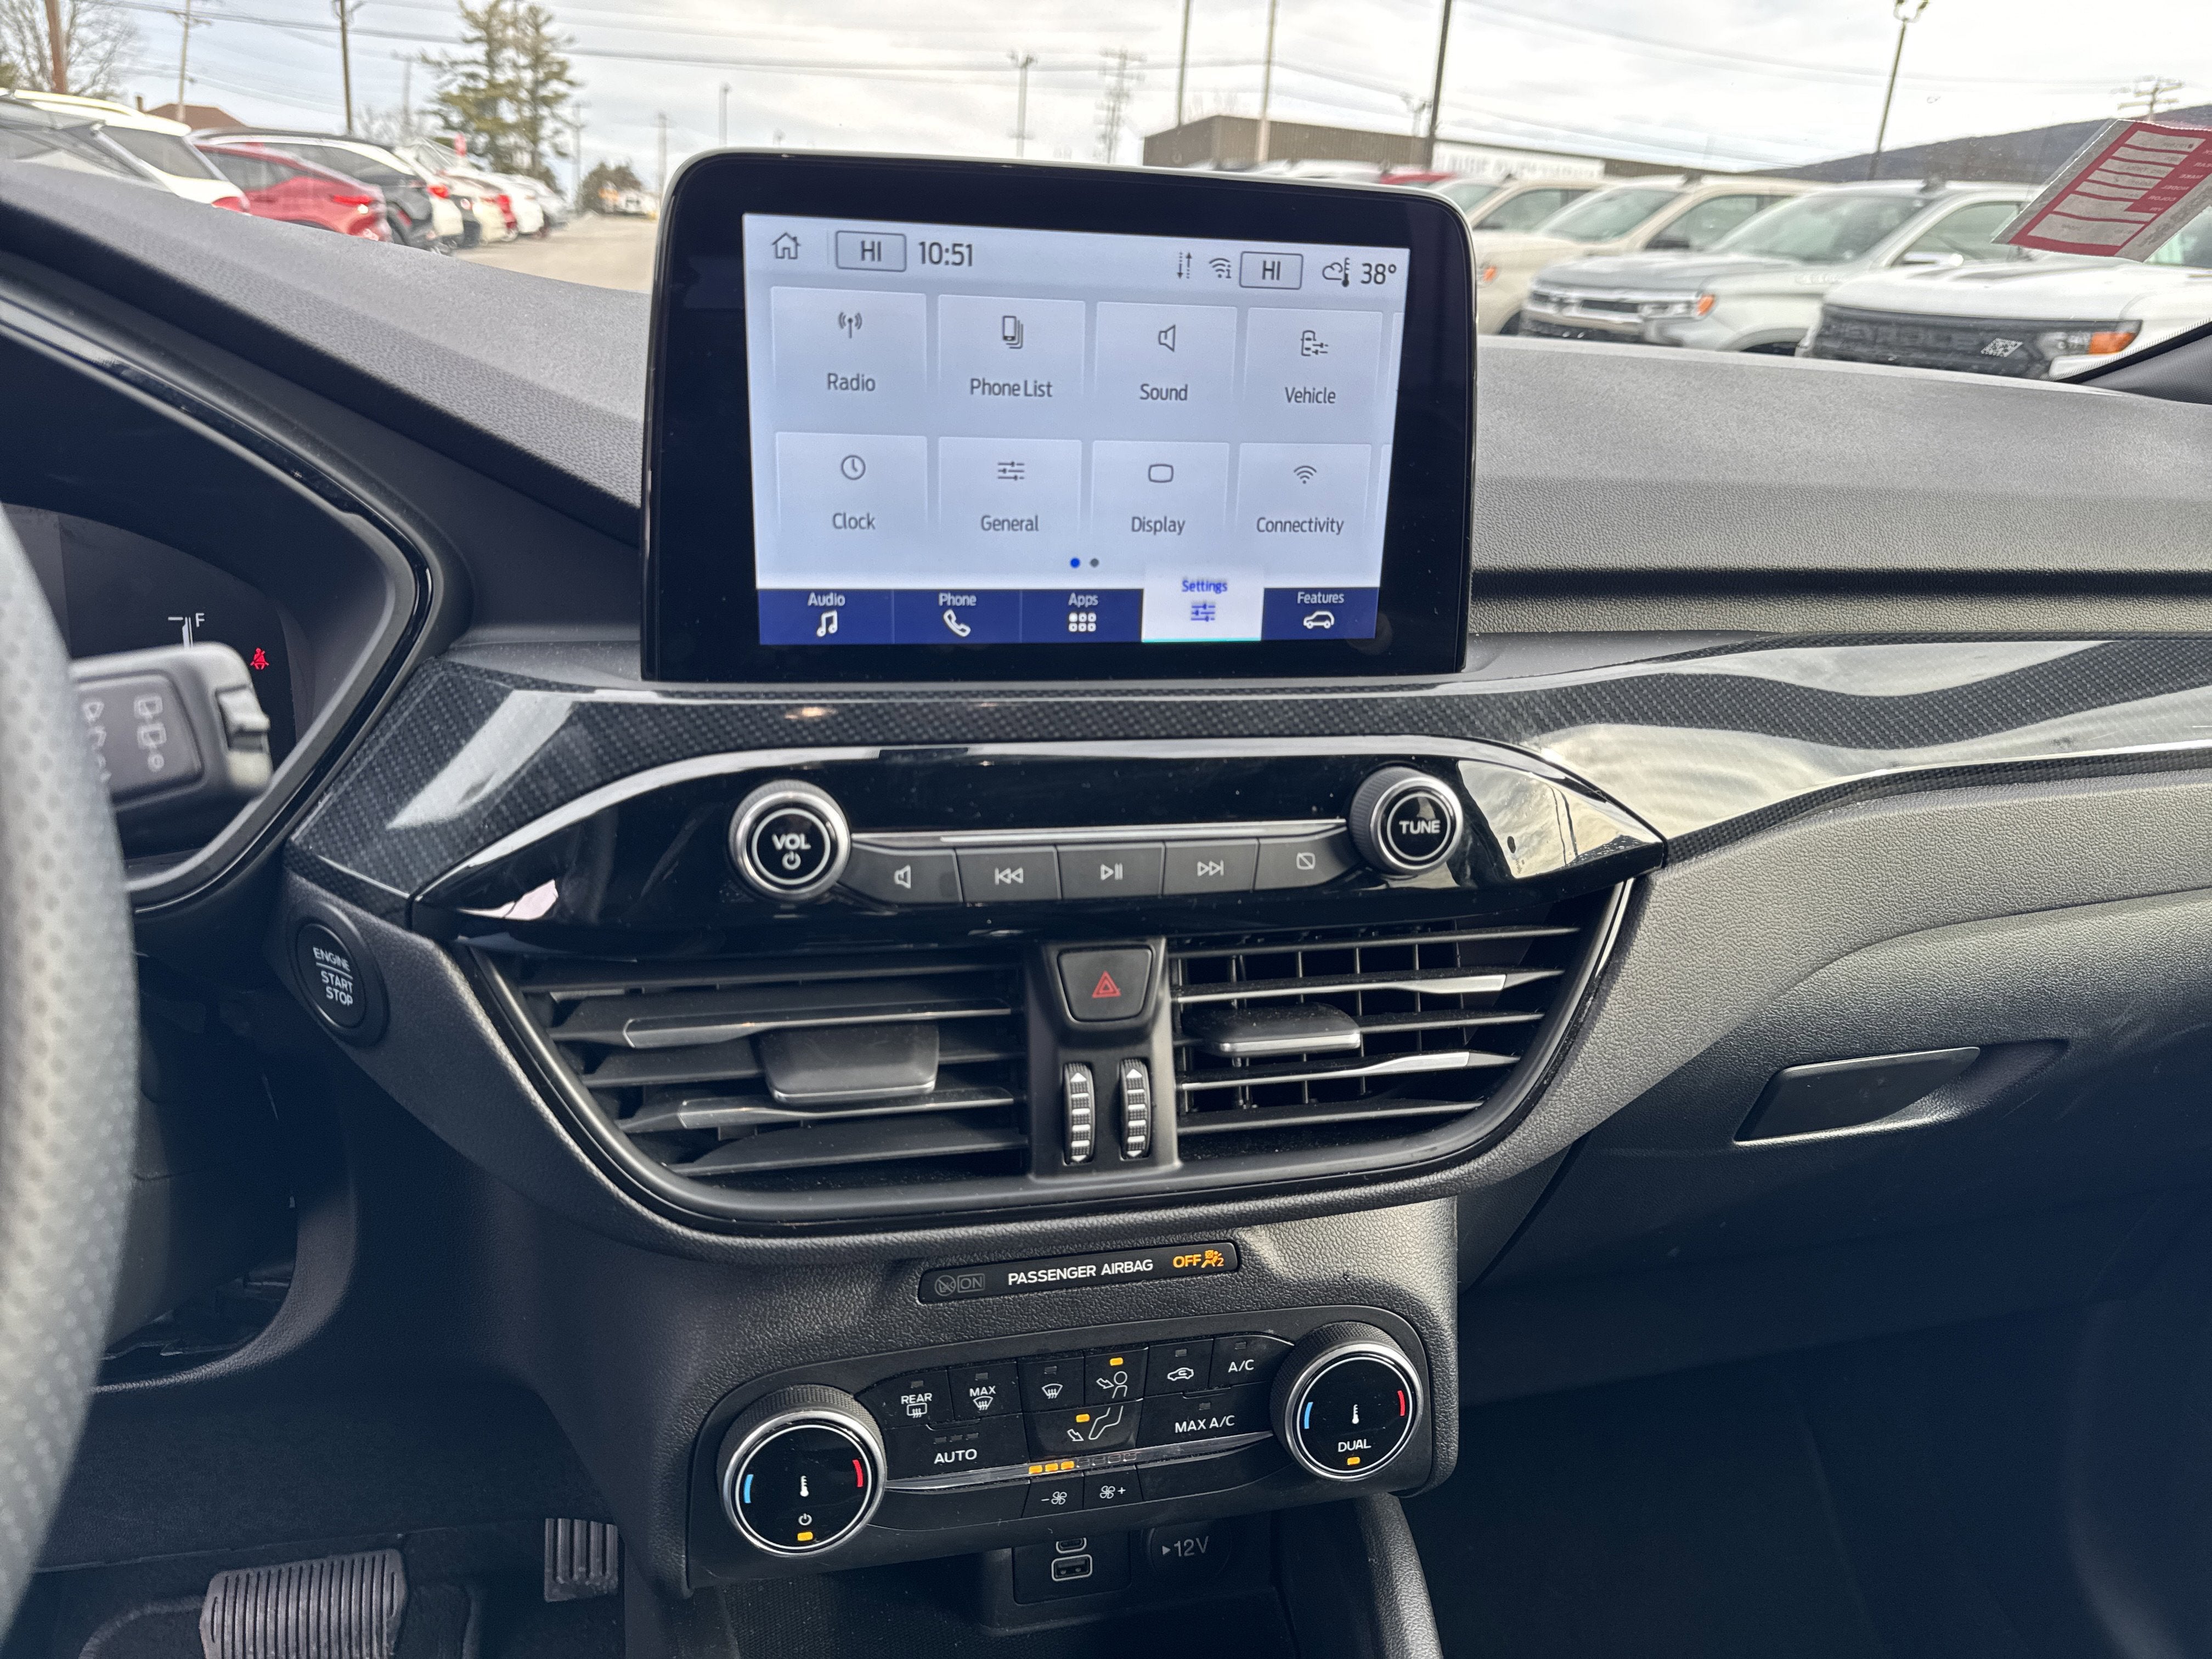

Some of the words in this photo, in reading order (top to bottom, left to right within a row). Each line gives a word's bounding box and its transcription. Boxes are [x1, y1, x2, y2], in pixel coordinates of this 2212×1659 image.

[861, 240, 882, 262] HI
[919, 242, 974, 267] 10:51
[1262, 260, 1280, 281] HI
[827, 373, 876, 392] Radio
[970, 378, 1020, 397] Phone
[1024, 380, 1053, 398] List
[1139, 383, 1188, 402] Sound
[1285, 387, 1336, 404] Vehicle
[832, 512, 876, 531] Clock
[981, 515, 1039, 532] General
[1131, 516, 1186, 535] Display
[1256, 517, 1345, 535] Connectivity
[1182, 579, 1228, 594] Settings
[808, 592, 845, 607] Audio
[939, 592, 977, 607] Phone
[1069, 593, 1098, 608] Apps
[1297, 591, 1344, 605] Features
[195, 612, 205, 627] F
[1398, 819, 1441, 835] TUNE
[771, 834, 811, 850] VOL
[313, 947, 351, 972] ENGINE
[321, 970, 353, 994] START
[326, 986, 353, 1006] STOP
[960, 1276, 983, 1290] ON
[1008, 1265, 1096, 1285] PASSENGER
[1101, 1259, 1154, 1276] AIRBAG
[1173, 1254, 1201, 1268] OFF
[1228, 1359, 1255, 1373] A/C
[901, 1392, 932, 1404] REAR
[969, 1385, 996, 1397] MAX
[1175, 1419, 1206, 1434] MAX
[1209, 1415, 1235, 1429] A/C
[1338, 1438, 1372, 1453] DUAL
[934, 1448, 978, 1464] AUTO
[1174, 1536, 1209, 1556] 12V
